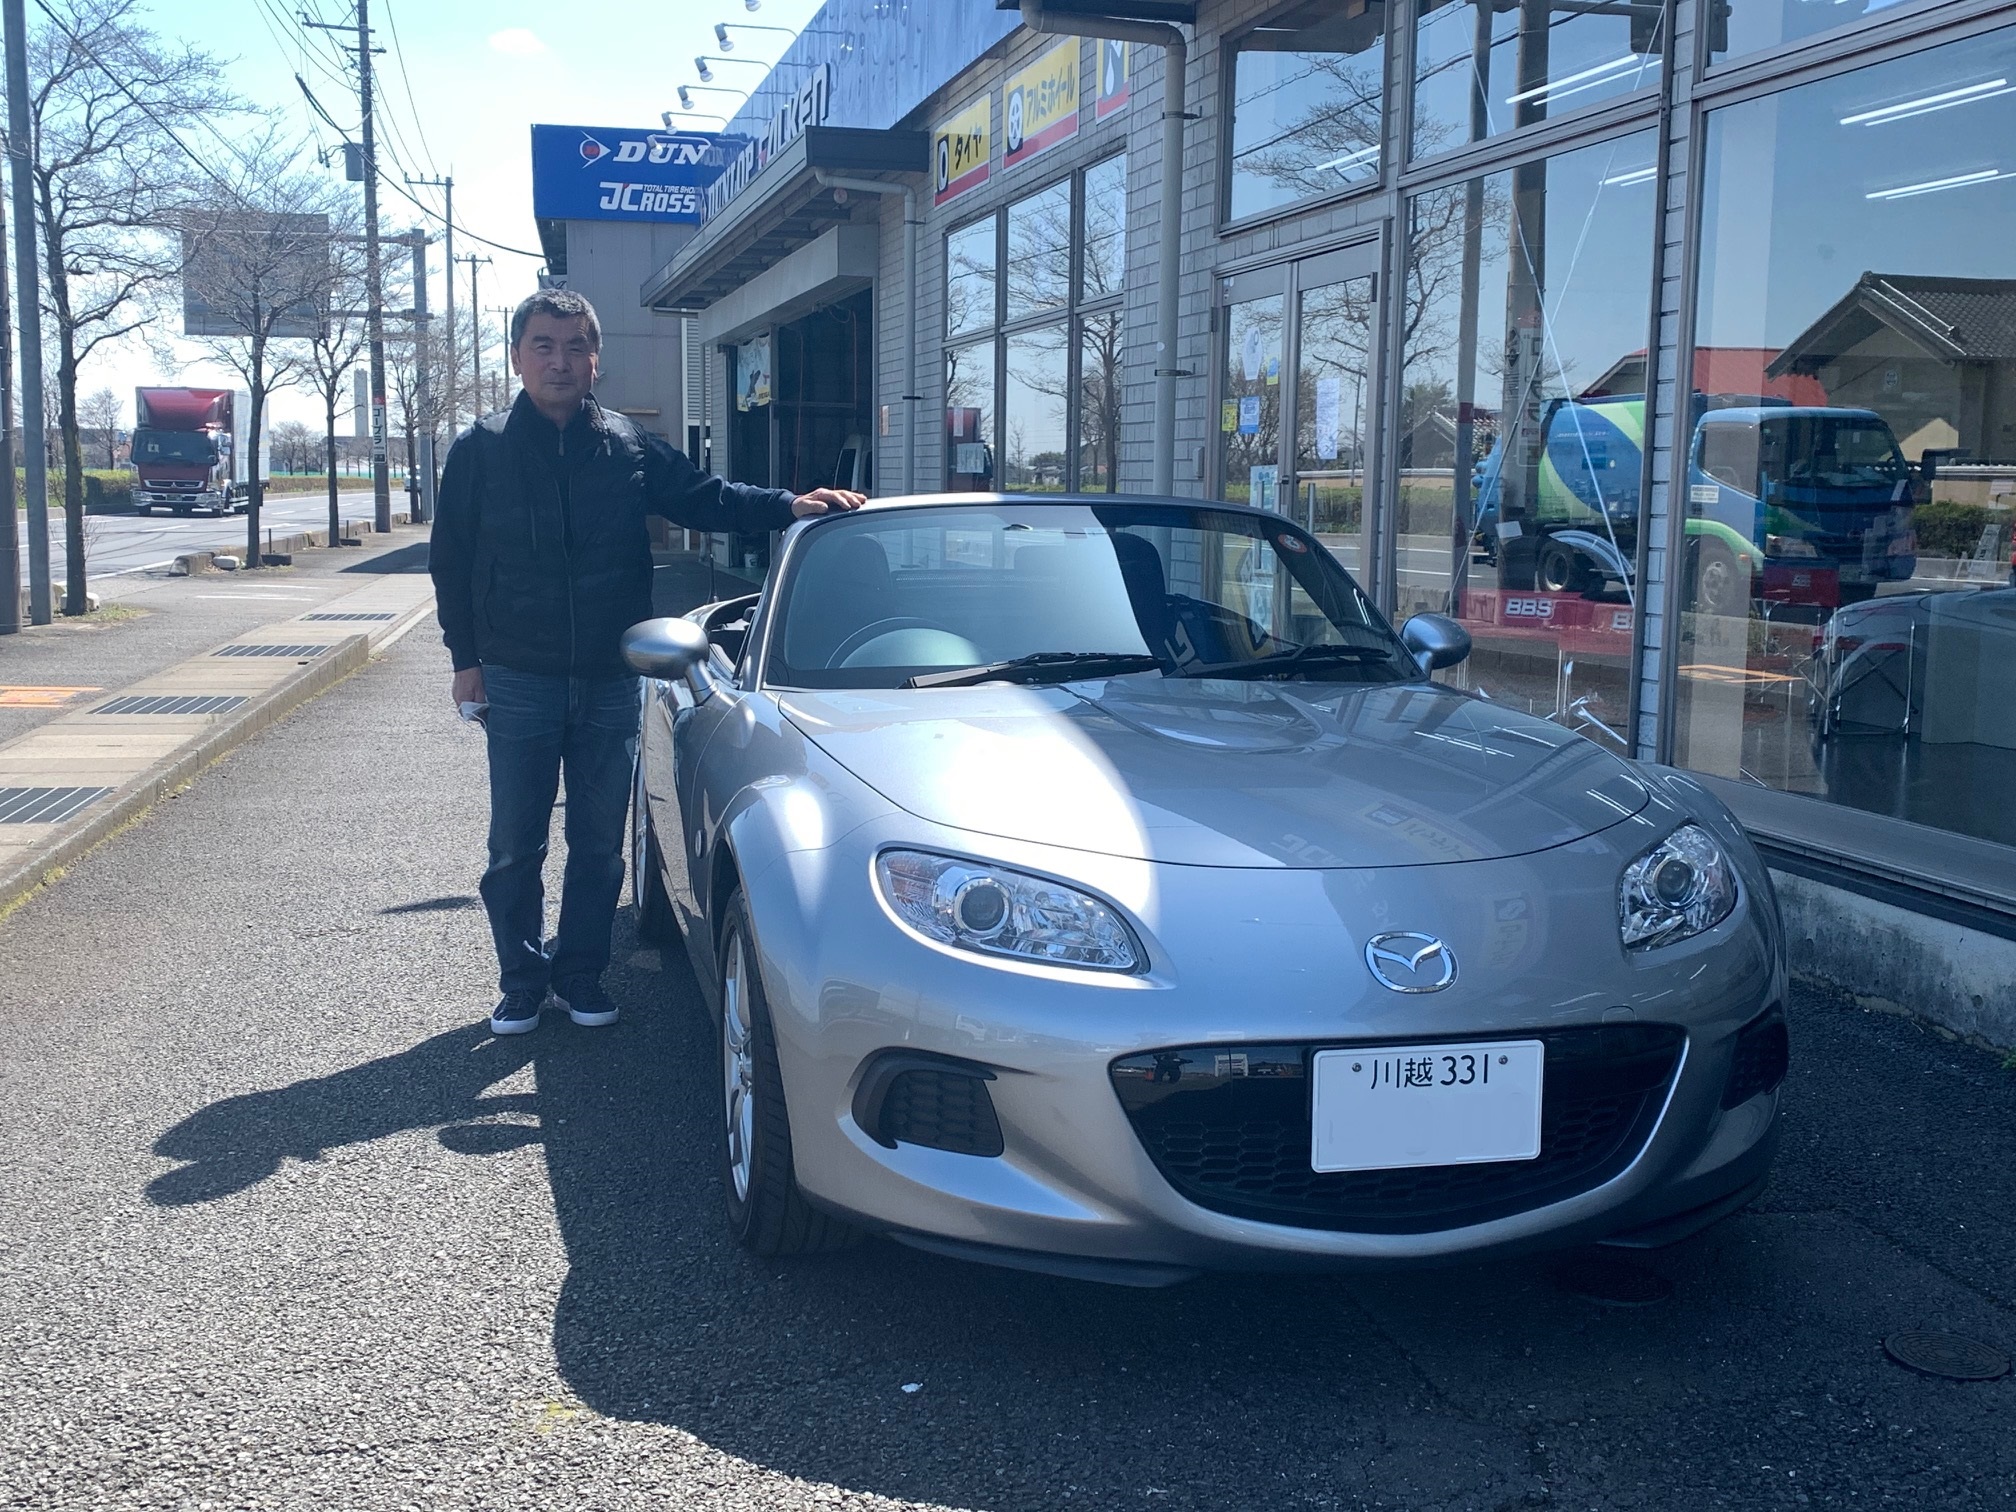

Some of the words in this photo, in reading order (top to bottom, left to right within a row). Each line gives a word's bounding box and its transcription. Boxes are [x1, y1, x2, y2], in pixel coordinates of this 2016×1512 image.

[1025, 61, 1076, 128] アルミホイール
[954, 122, 983, 171] タイヤ
[643, 184, 663, 193] TOTAL
[664, 185, 679, 193] TIRE
[679, 185, 696, 194] SHO
[1504, 597, 1553, 618] BBS
